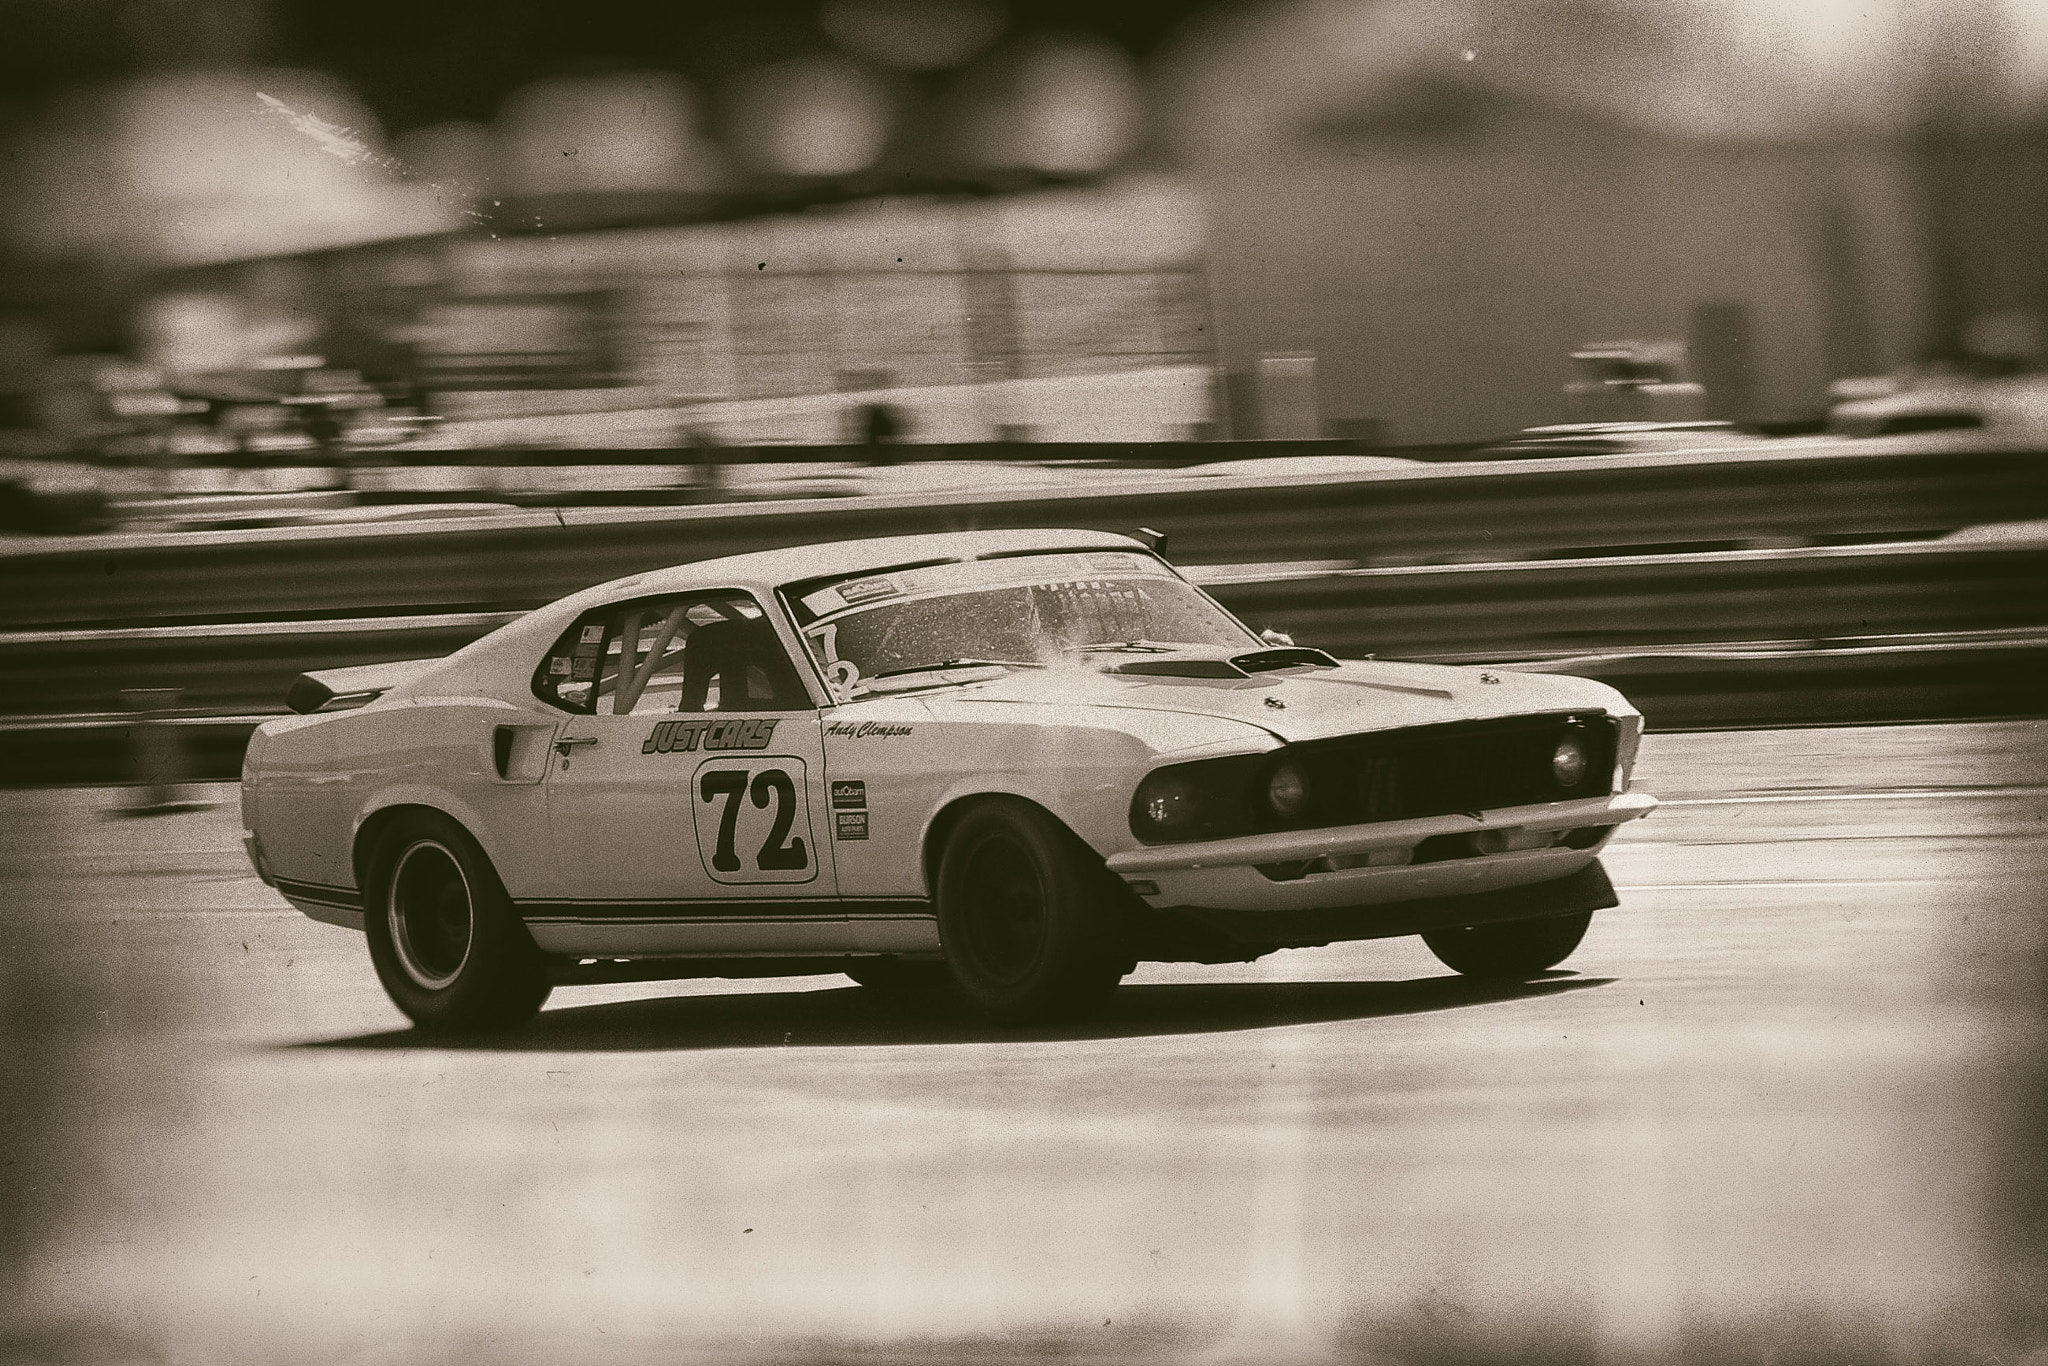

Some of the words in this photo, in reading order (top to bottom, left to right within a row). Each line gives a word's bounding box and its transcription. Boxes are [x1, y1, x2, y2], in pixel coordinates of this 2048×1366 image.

[807, 623, 870, 701] 72
[642, 720, 713, 754] JUST
[704, 719, 780, 751] CARS
[824, 721, 857, 740] Andy
[857, 721, 913, 740] Clempson
[700, 769, 808, 872] 72
[839, 814, 865, 825] BURSON
